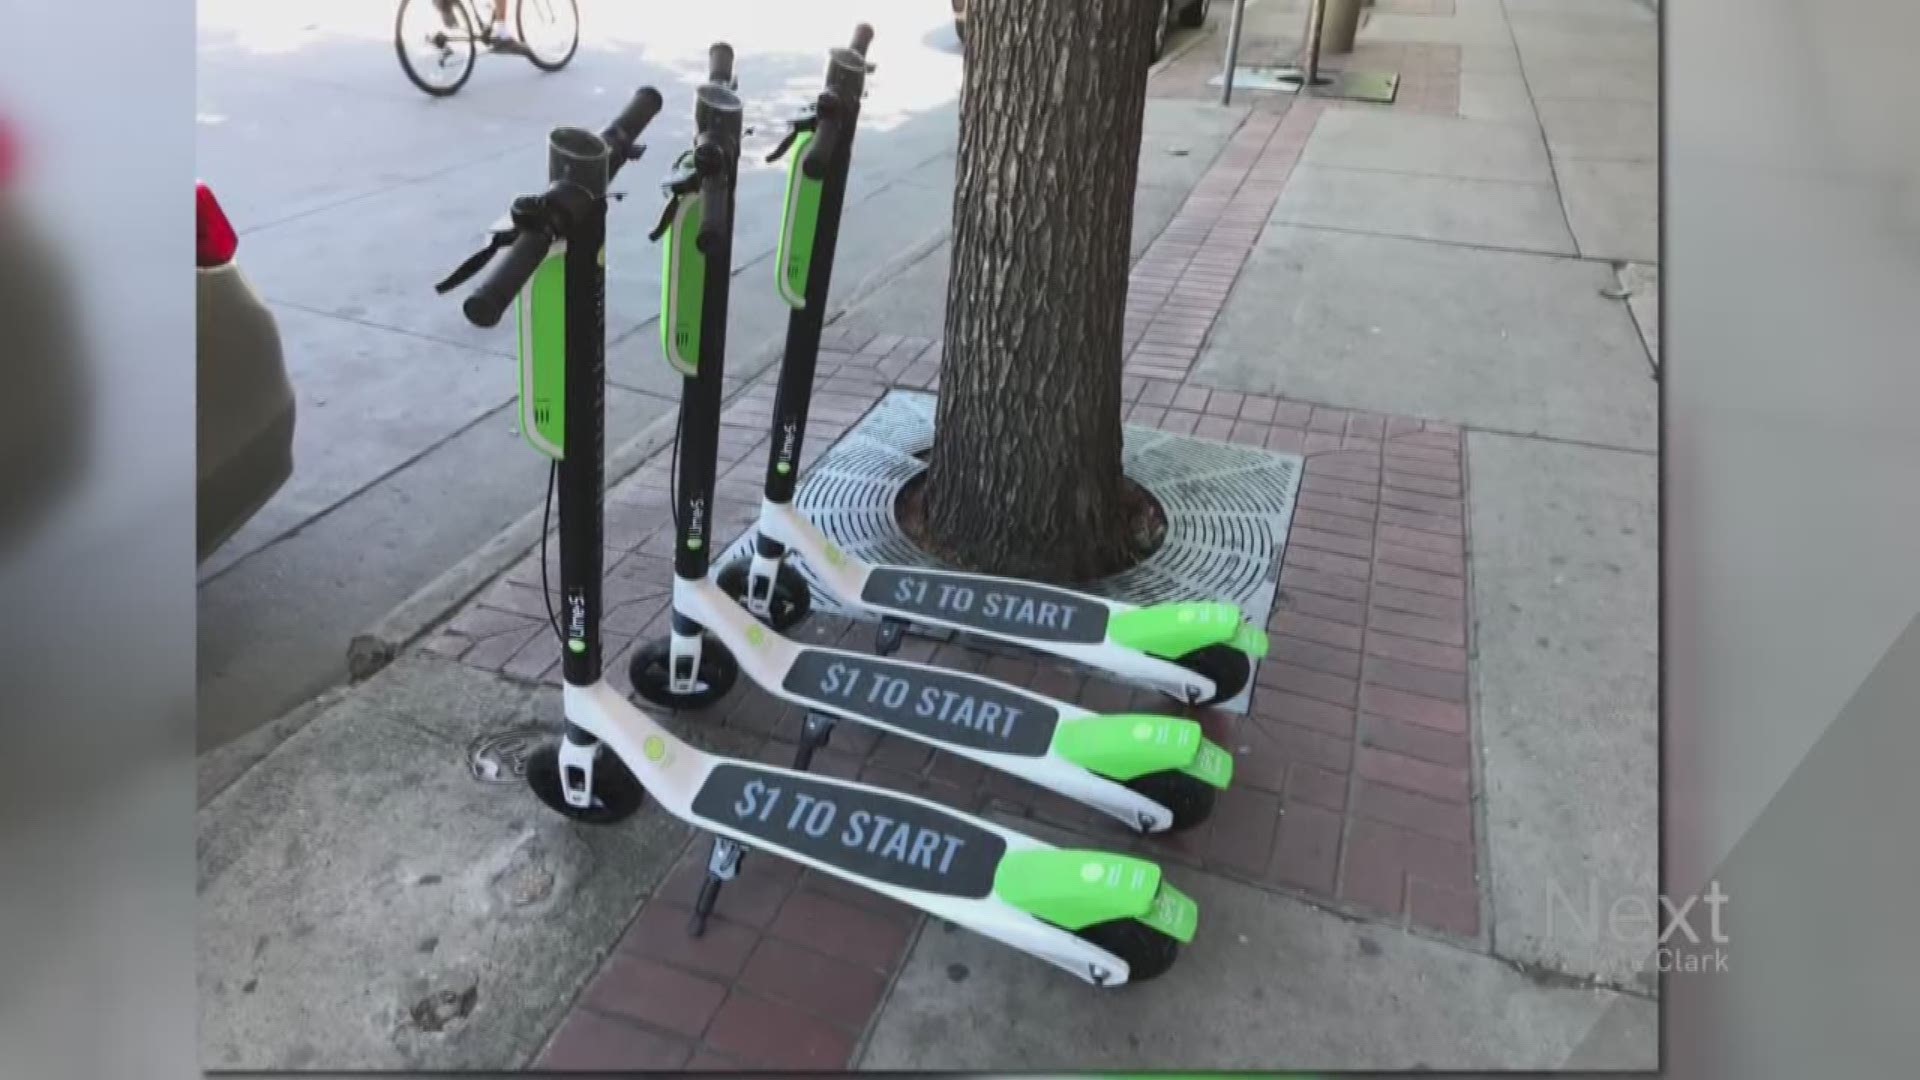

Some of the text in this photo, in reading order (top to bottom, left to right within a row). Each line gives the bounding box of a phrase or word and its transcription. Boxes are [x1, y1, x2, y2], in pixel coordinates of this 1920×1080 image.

[894, 577, 1078, 631] $1 TO START
[820, 662, 1023, 739] $1 TO START
[734, 779, 965, 875] $1 TO START
